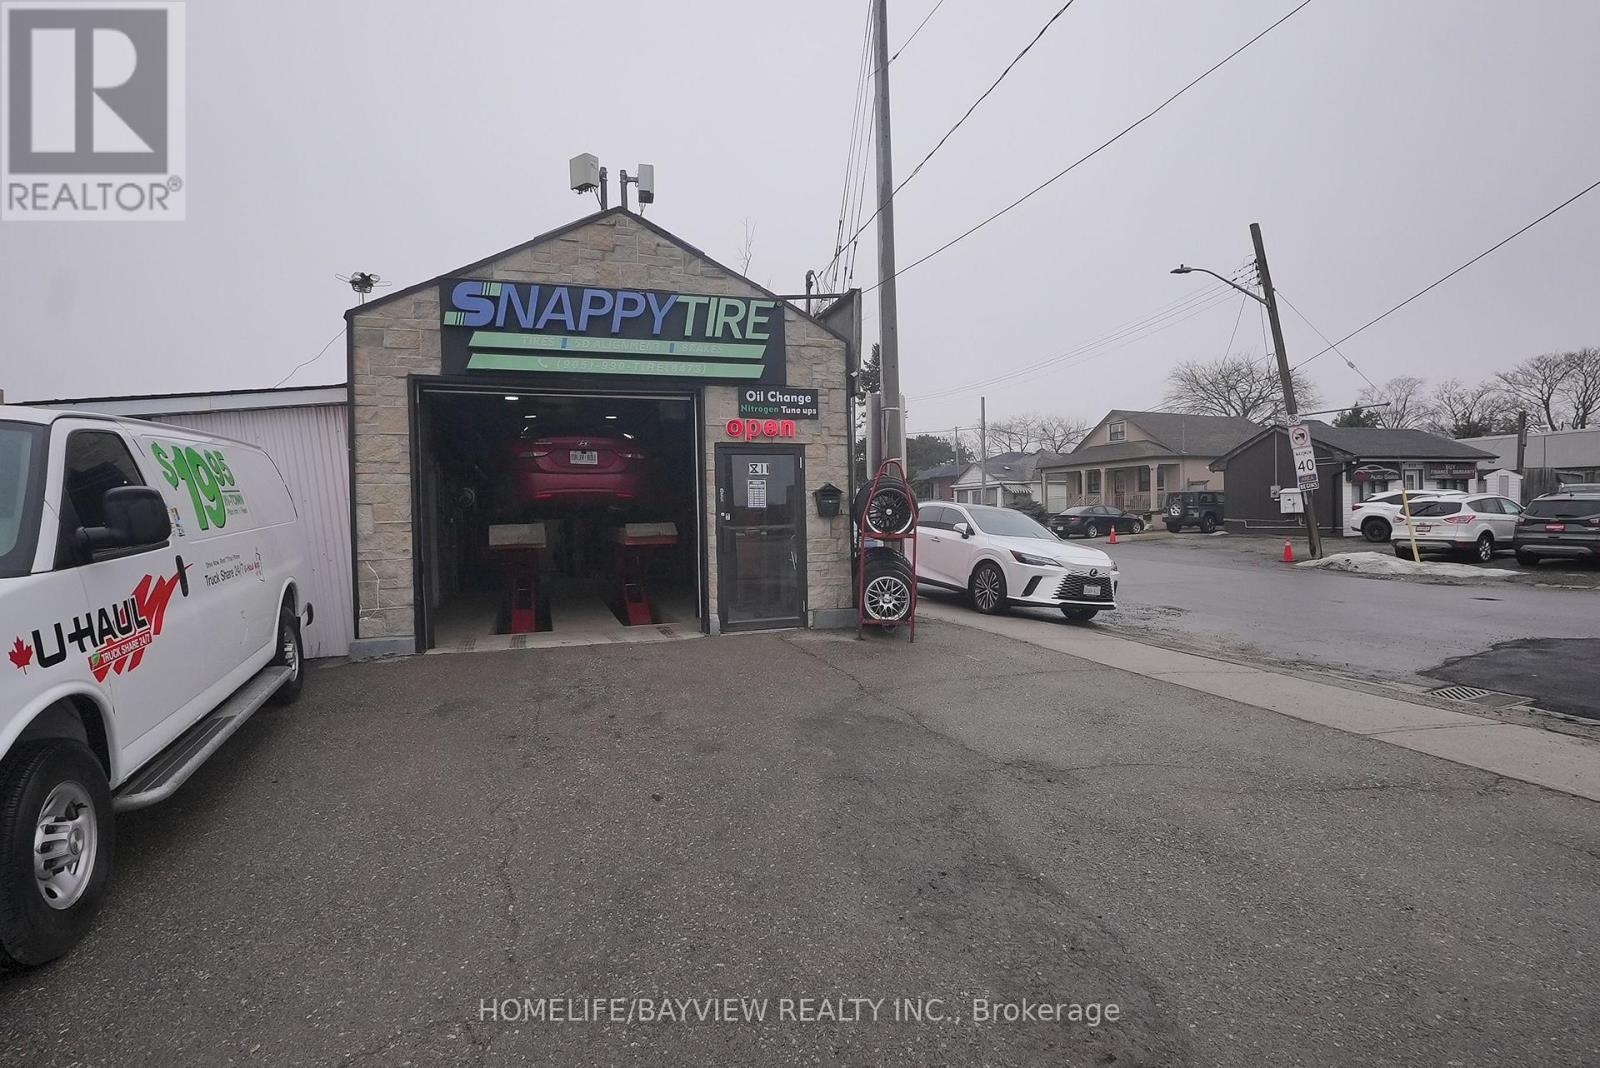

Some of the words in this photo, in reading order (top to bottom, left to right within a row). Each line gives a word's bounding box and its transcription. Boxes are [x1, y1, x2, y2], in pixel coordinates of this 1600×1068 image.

[520, 335, 555, 347] TIRES
[590, 340, 661, 352] ALIGNMENT
[746, 390, 764, 402] Oil
[767, 391, 812, 405] Change
[740, 404, 779, 415] Nitrogen
[781, 406, 802, 414] Tune
[726, 418, 796, 442] open
[1298, 458, 1315, 472] 40
[204, 571, 220, 587] Truck
[219, 568, 235, 582] Share
[32, 597, 148, 669] U-HAUL
[101, 646, 122, 664] TRUCK
[120, 638, 140, 655] SHARE
[138, 633, 151, 646] 24/7
